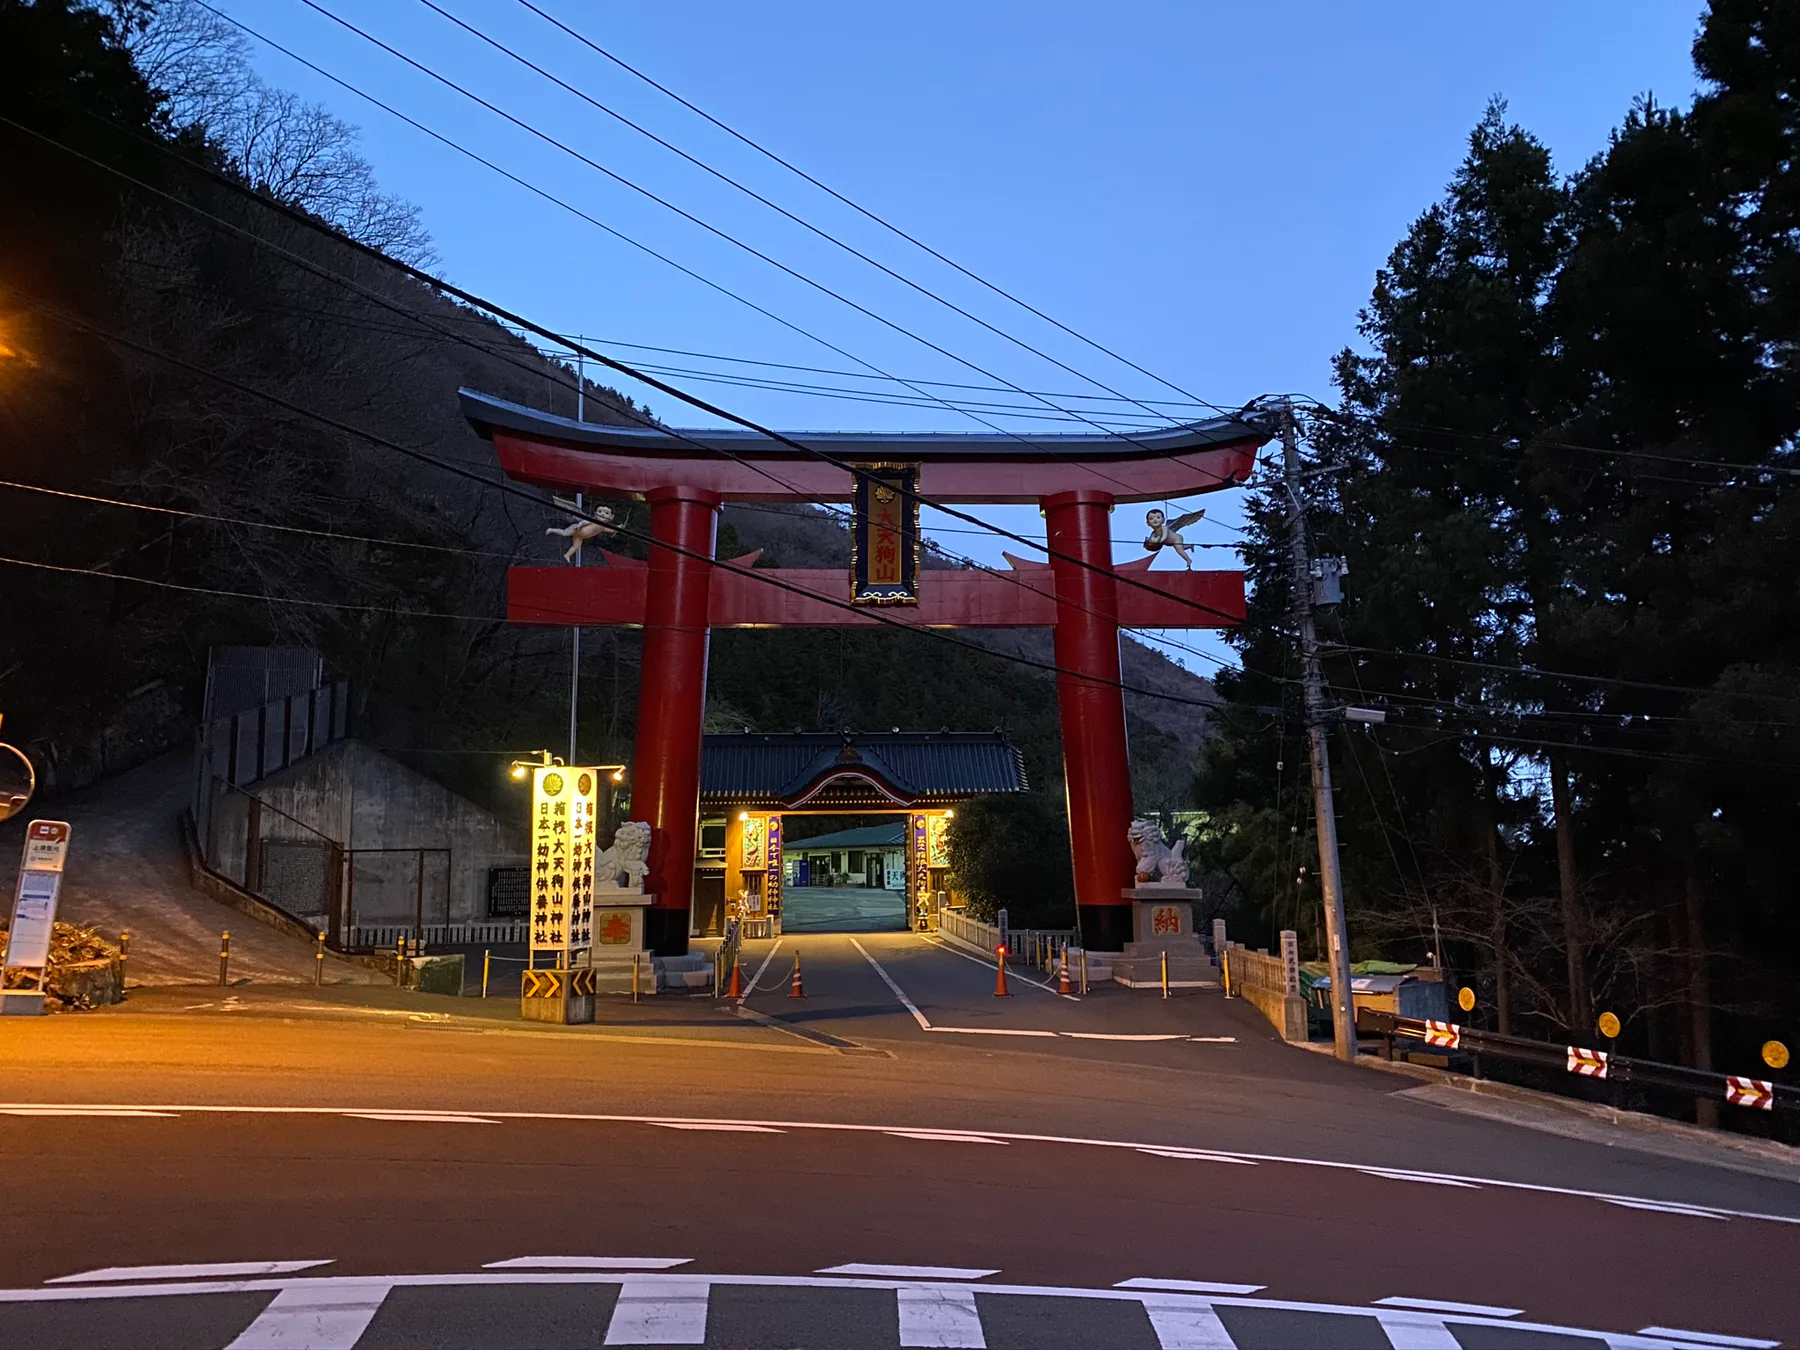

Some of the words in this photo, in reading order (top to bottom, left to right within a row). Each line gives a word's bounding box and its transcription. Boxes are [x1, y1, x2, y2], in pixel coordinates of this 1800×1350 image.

[534, 802, 551, 944] 日本一幼神供養神社
[550, 801, 567, 944] 箱根大天狗山神社
[1154, 907, 1180, 935] 納
